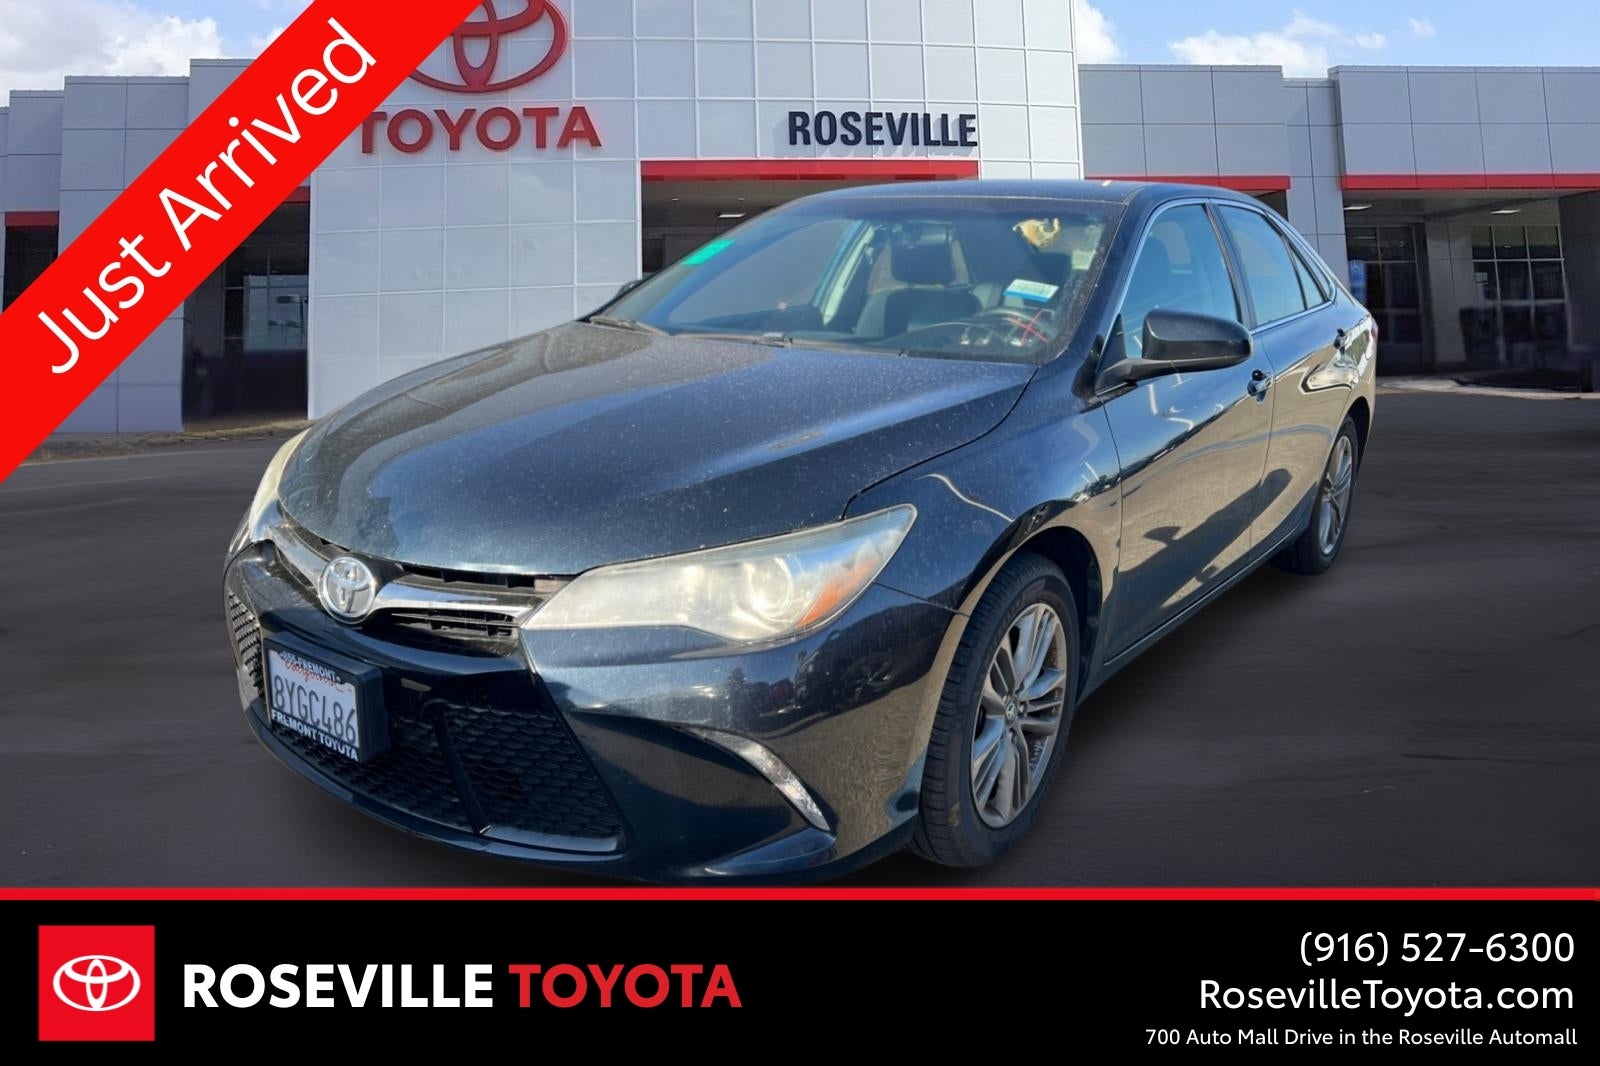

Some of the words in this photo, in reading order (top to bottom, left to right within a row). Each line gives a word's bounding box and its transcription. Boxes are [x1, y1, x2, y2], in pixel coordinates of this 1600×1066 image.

[361, 106, 601, 154] TOYOTA
[788, 111, 978, 147] ROSEVILLE
[272, 710, 317, 740] FREMONT
[274, 675, 356, 744] 8YGC486
